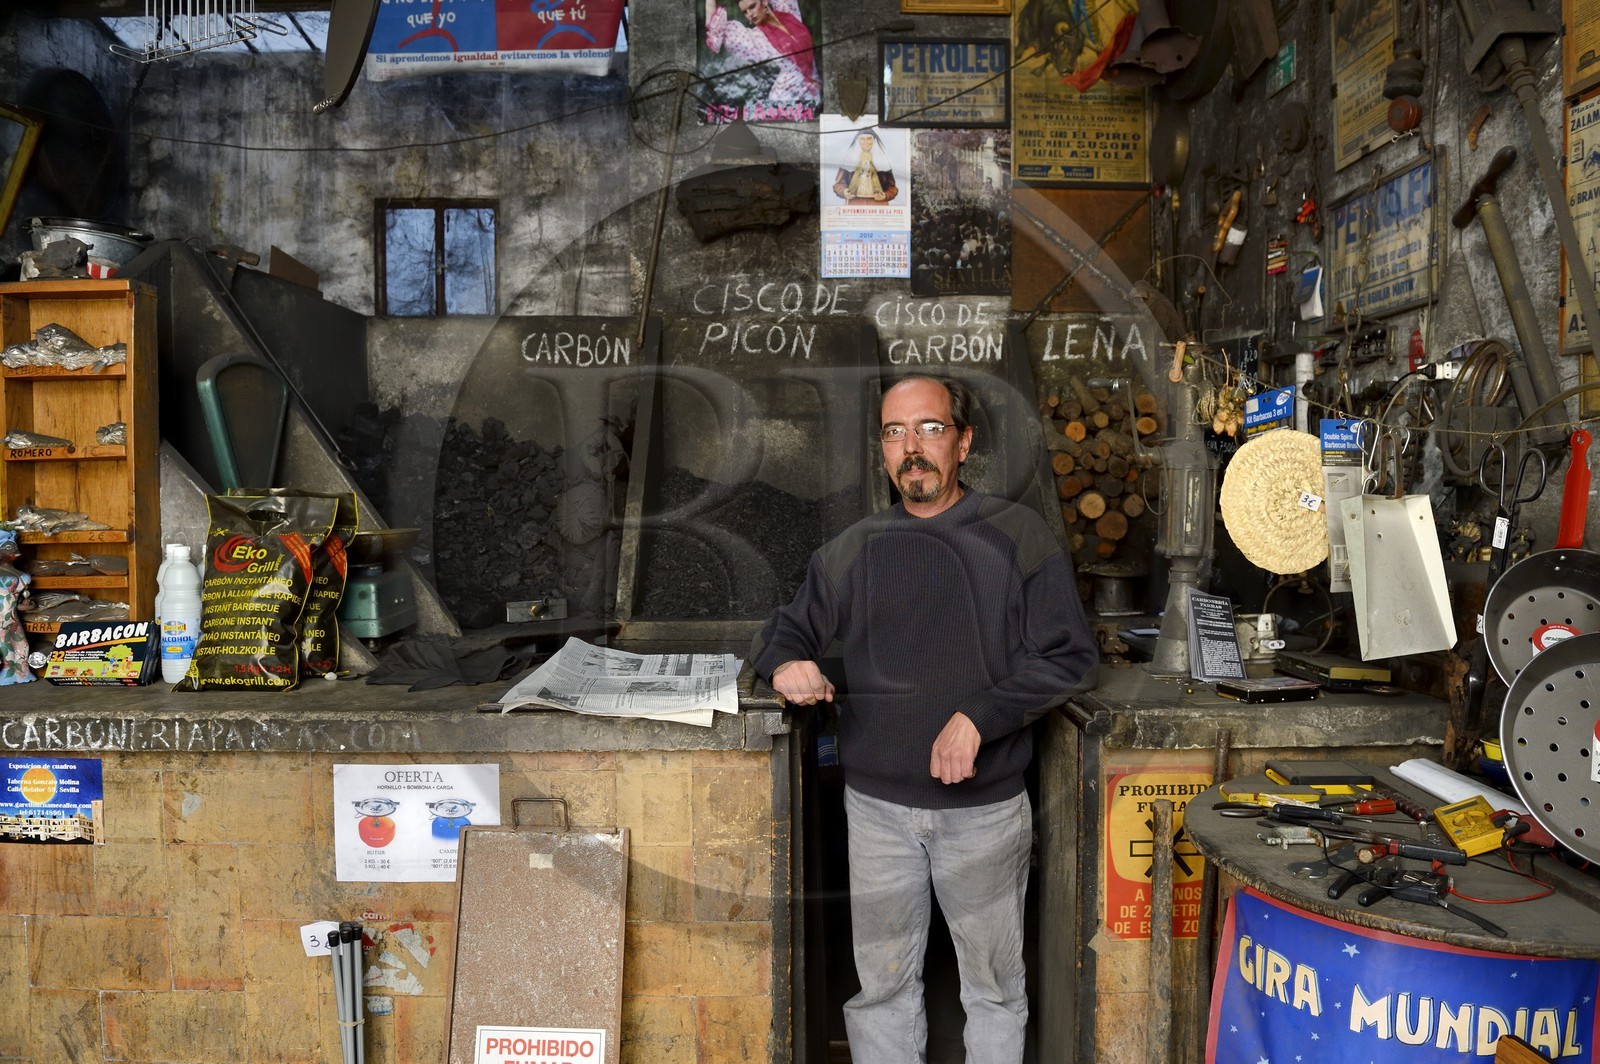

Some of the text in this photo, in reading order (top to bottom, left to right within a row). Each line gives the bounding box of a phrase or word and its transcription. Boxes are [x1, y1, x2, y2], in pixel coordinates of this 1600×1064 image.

[376, 55, 387, 63] Si
[390, 54, 450, 64] aprendemos
[454, 52, 498, 62] igualdad
[501, 51, 557, 60] evitaremos
[561, 50, 570, 58] la
[884, 43, 1005, 73] PETROLEO
[1072, 131, 1087, 139] EL
[1096, 132, 1142, 141] PIREO
[1022, 140, 1042, 148] JOSE
[1076, 140, 1138, 150] SUSONI
[1070, 150, 1134, 160] ASTOLA
[694, 283, 850, 316] CISCO DE
[958, 302, 991, 326] DE
[699, 311, 818, 360] PICÓN
[521, 323, 630, 367] CARBÓN
[888, 326, 1004, 364] CARBÓN
[1253, 411, 1272, 423] Barbacoa
[1340, 433, 1354, 441] Spiral
[10, 448, 52, 458] ROMERO
[88, 532, 94, 542] 2
[232, 546, 268, 560] Eko
[246, 562, 275, 574] Grill
[204, 575, 293, 588] CARBÓN INSTANTÁNEO
[314, 590, 340, 600] RAPIDE
[232, 603, 280, 612] BARBECUE
[204, 617, 275, 628] CARBONE INSTANT
[50, 651, 64, 662] 32
[200, 677, 291, 686] www.ekogrill.com
[384, 771, 444, 782] OFERTA
[1134, 888, 1144, 902] A
[1120, 906, 1136, 918] DE
[1114, 922, 1130, 934] DE
[310, 935, 320, 948] 3
[1239, 934, 1323, 1018] GIRA
[1350, 983, 1582, 1060] MUNDIAL
[486, 1038, 594, 1058] PROHIBIDO
